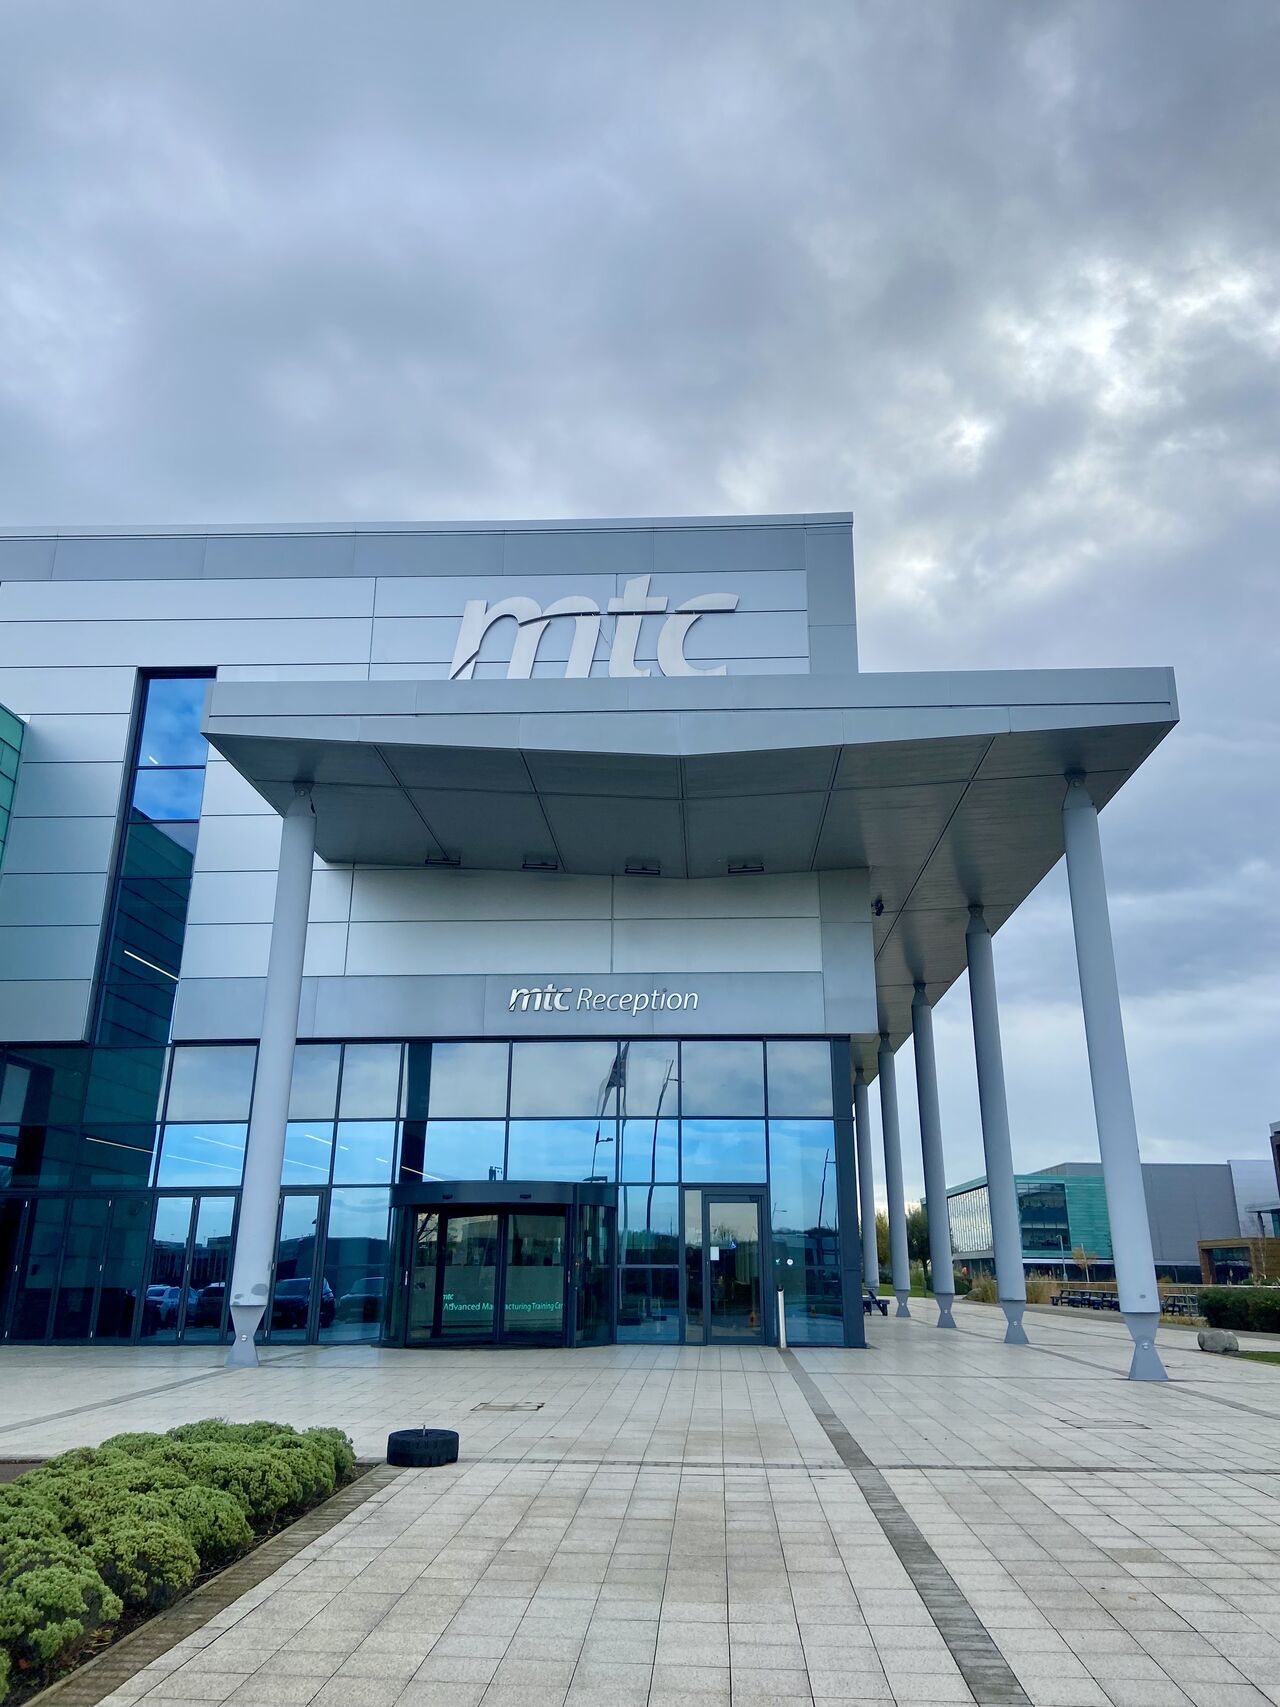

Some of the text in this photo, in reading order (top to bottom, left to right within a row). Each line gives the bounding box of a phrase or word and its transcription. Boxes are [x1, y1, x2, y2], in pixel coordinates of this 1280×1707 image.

[450, 574, 739, 680] mtc
[509, 984, 699, 1017] mtc Reception
[443, 1303, 480, 1311] Advanced
[532, 1302, 554, 1311] Training
